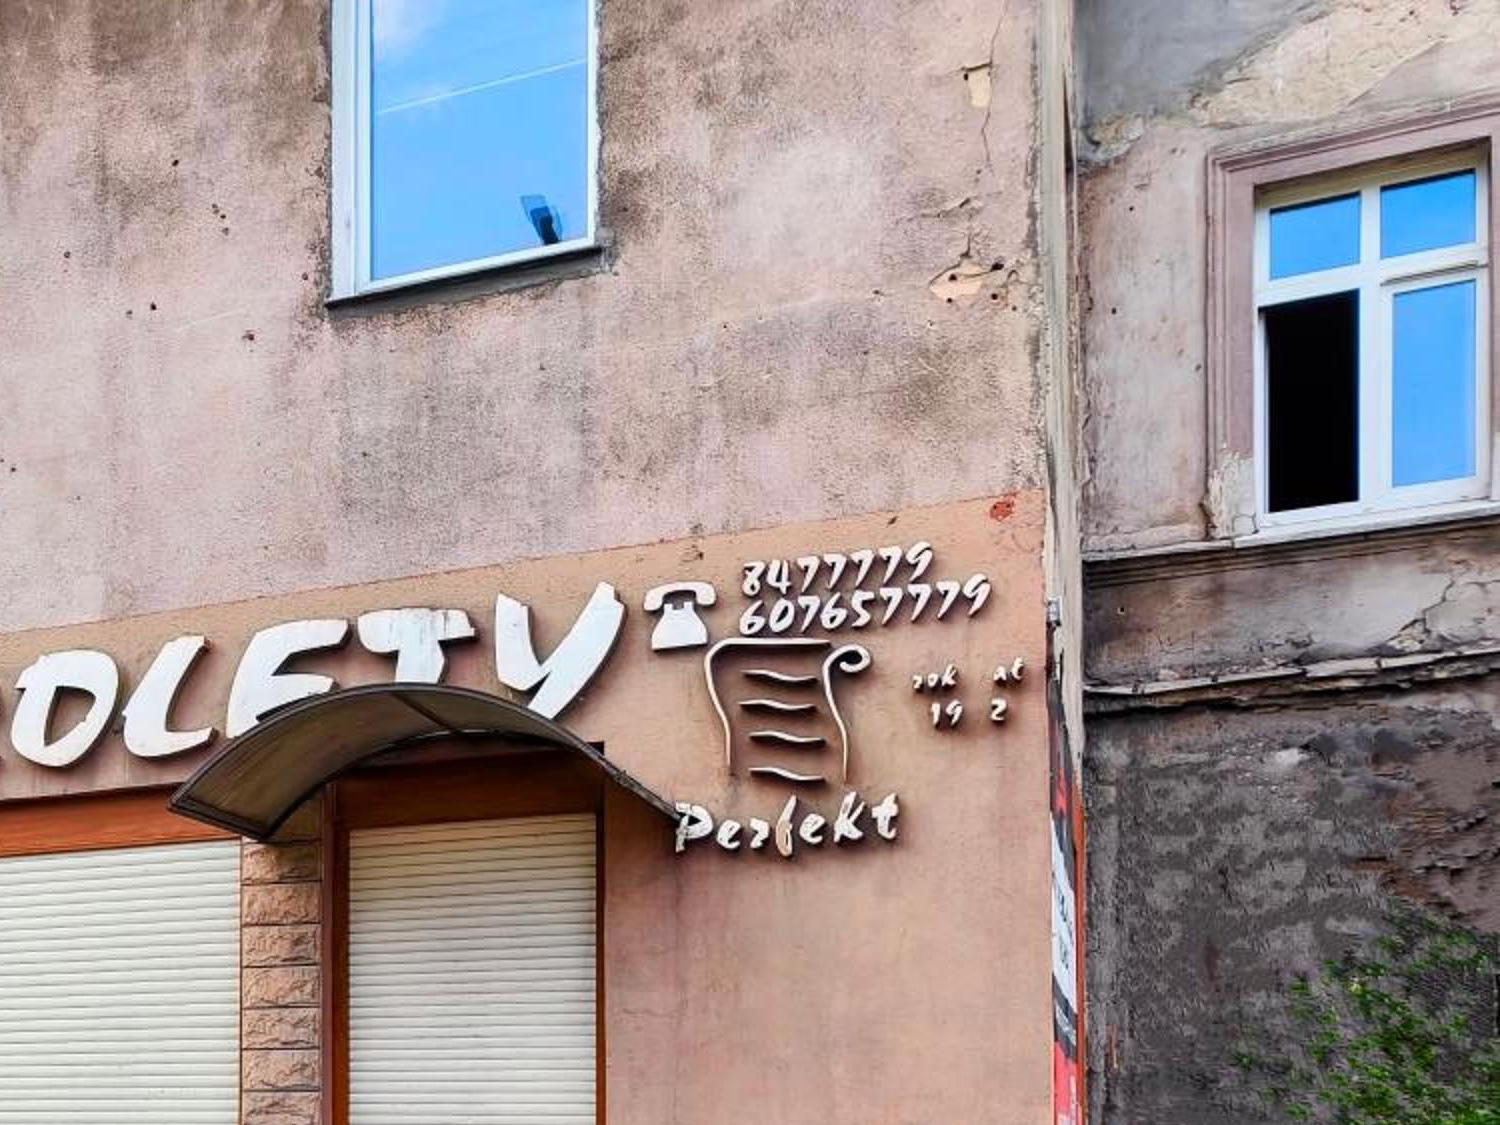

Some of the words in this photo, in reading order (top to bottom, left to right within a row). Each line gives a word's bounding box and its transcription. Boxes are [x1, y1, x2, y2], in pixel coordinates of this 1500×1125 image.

[741, 542, 933, 597] 8477779
[739, 573, 992, 637] 607657779
[930, 700, 963, 726] 19
[990, 698, 1007, 721] 2
[675, 791, 899, 858] Perfekt
